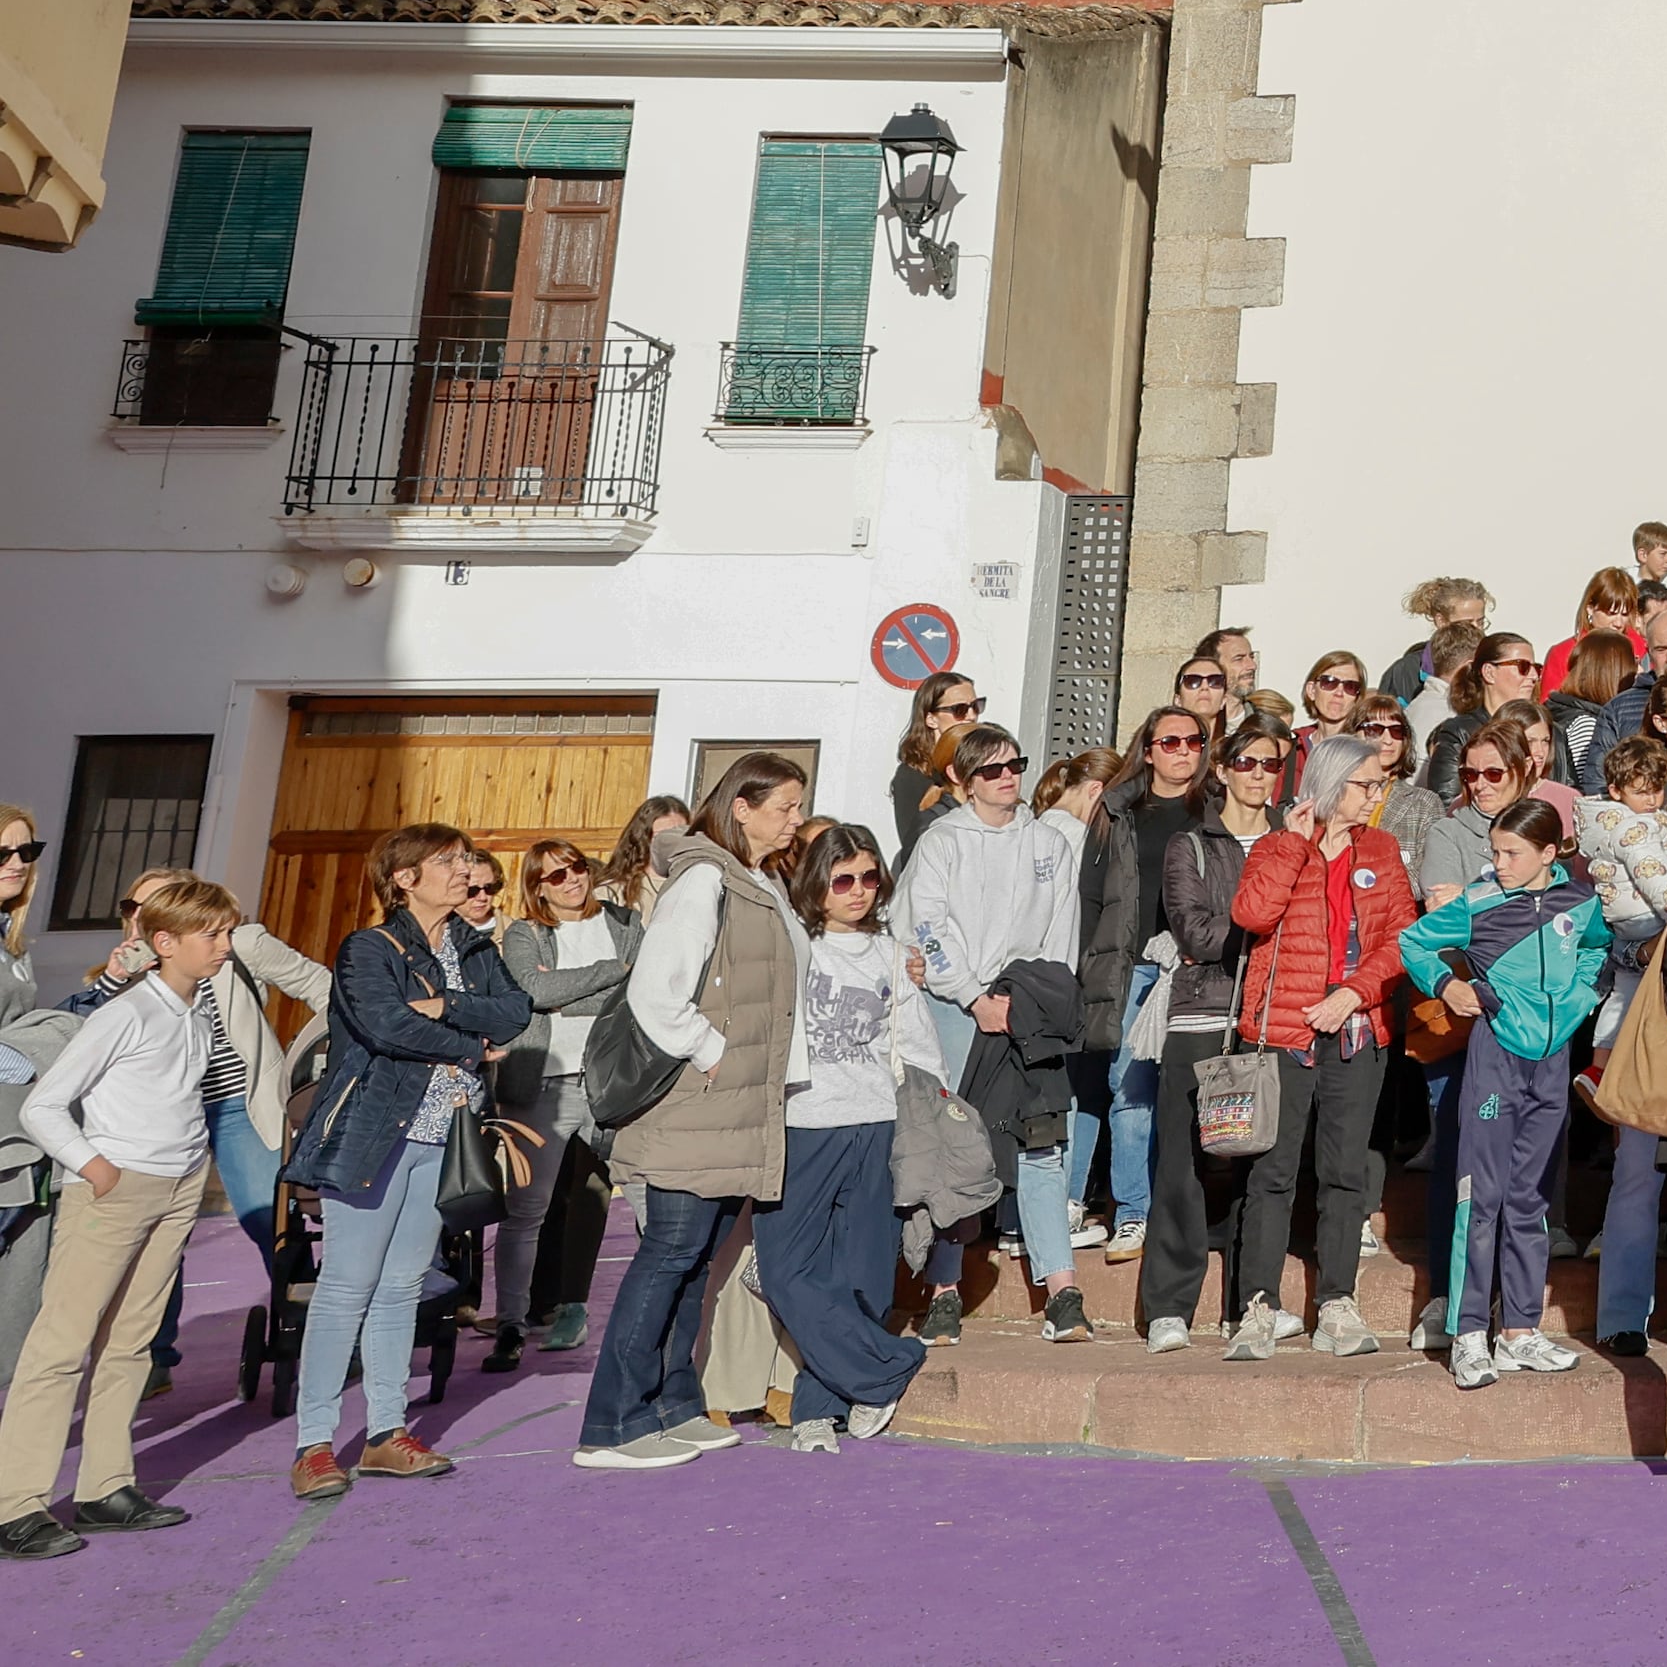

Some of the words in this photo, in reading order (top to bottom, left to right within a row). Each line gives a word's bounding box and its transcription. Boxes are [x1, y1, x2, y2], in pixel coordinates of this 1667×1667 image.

[983, 577, 994, 588] DE
[995, 576, 1007, 588] LA
[978, 588, 1010, 599] SANGRE
